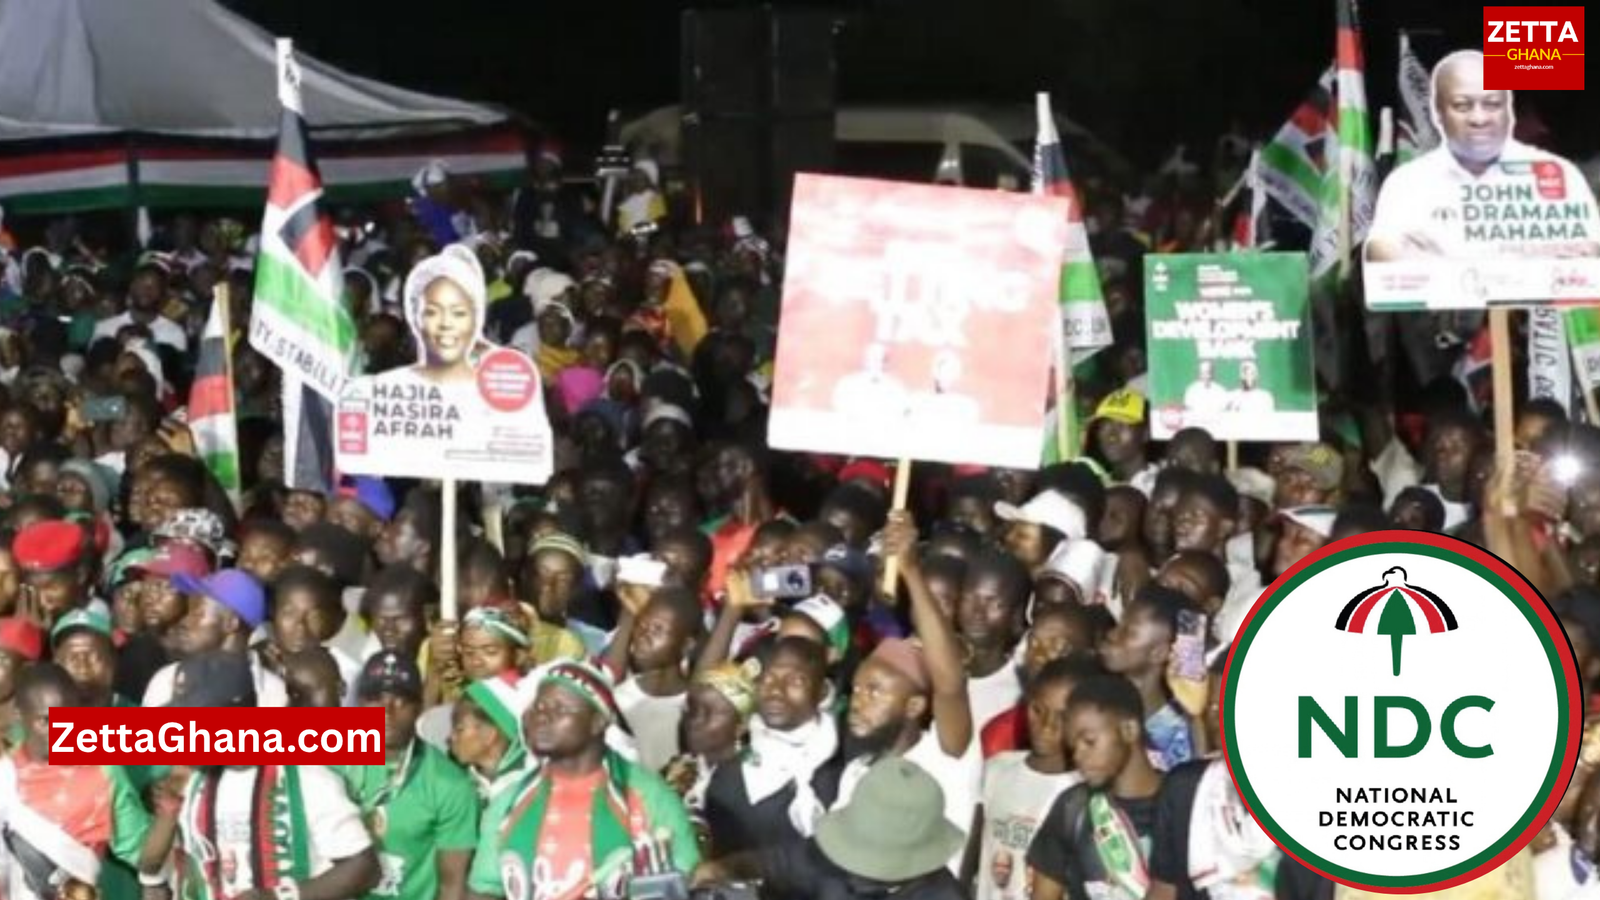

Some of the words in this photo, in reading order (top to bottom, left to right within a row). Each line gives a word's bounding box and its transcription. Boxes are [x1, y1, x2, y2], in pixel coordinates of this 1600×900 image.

[1460, 184, 1532, 202] JOHN
[1463, 203, 1590, 221] DRAMANI
[1464, 222, 1588, 242] MAHAMA
[1151, 320, 1301, 339] DEVELOPMENT
[372, 384, 443, 401] HAJIA
[373, 402, 462, 421] NASIRA
[373, 420, 454, 440] AFRAH
